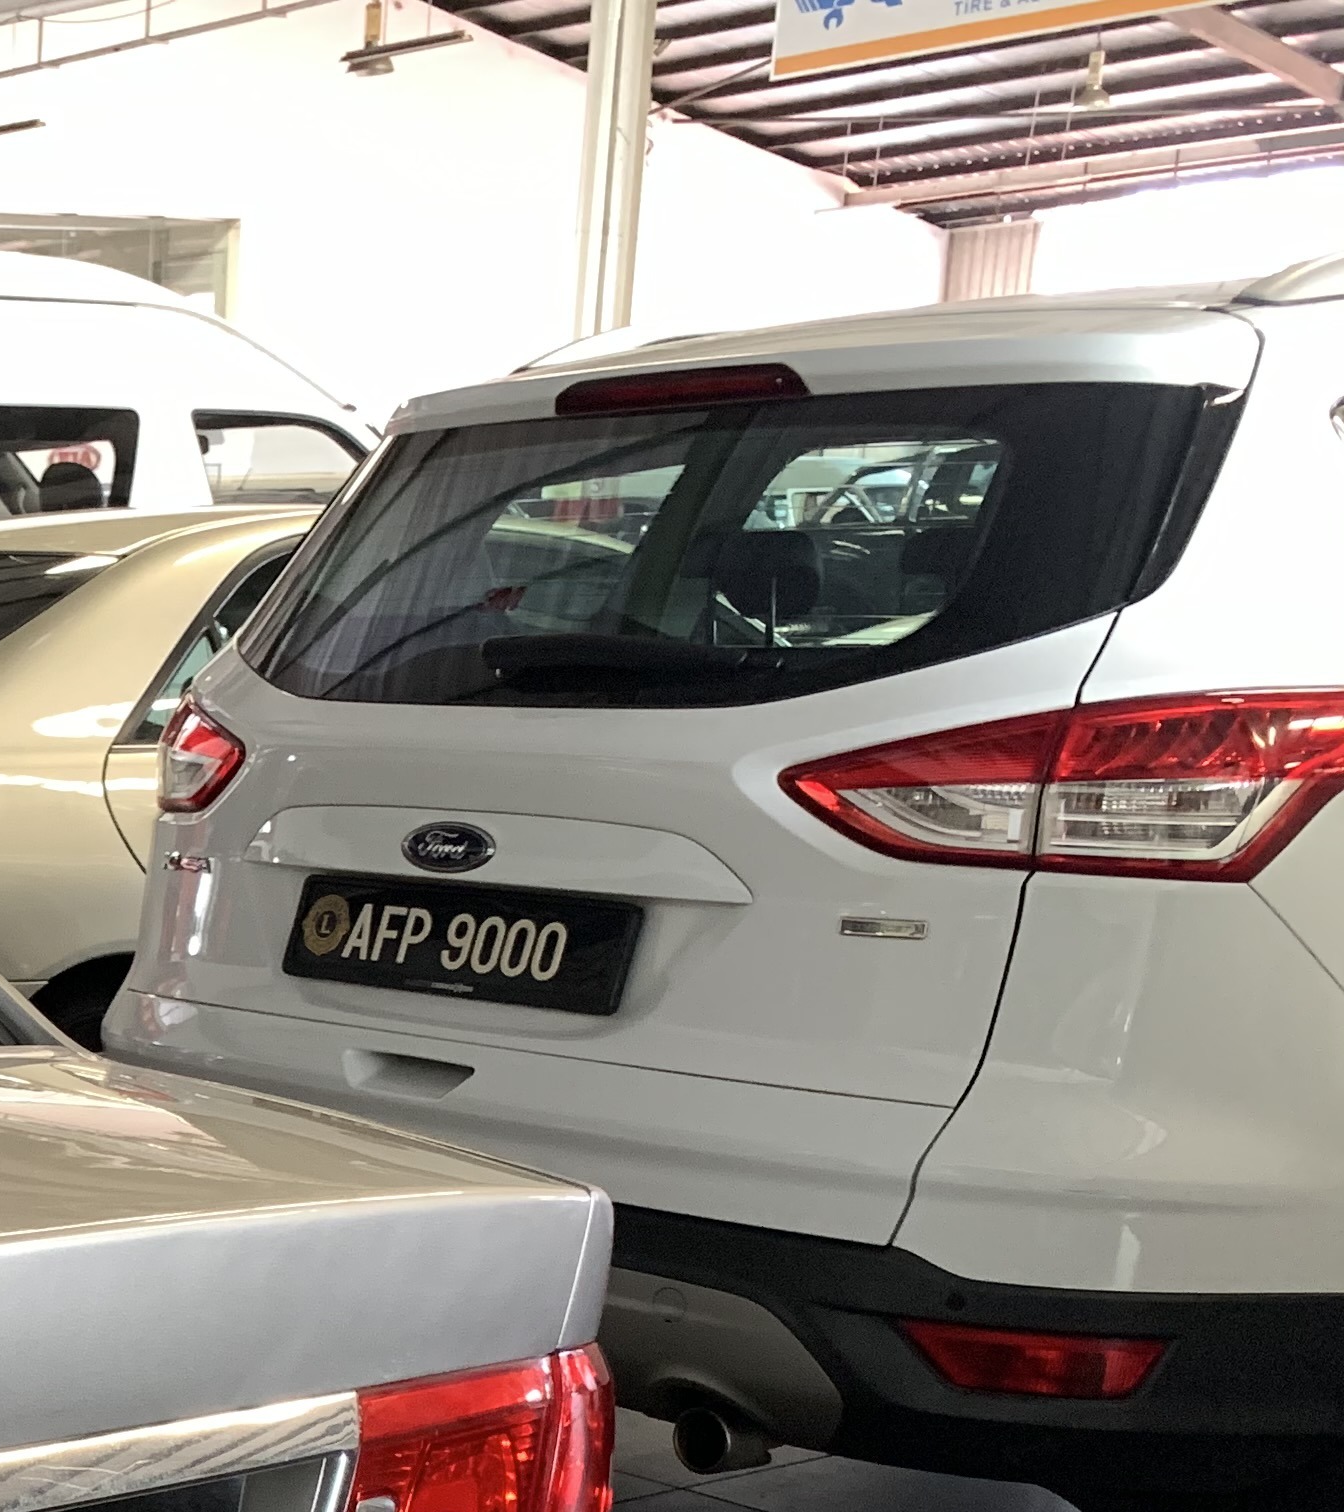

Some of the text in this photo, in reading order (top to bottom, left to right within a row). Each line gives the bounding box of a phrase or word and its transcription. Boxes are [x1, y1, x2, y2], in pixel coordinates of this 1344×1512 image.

[954, 0, 993, 16] TIRE
[417, 830, 469, 860] Ford
[341, 903, 567, 981] AFP 9000
